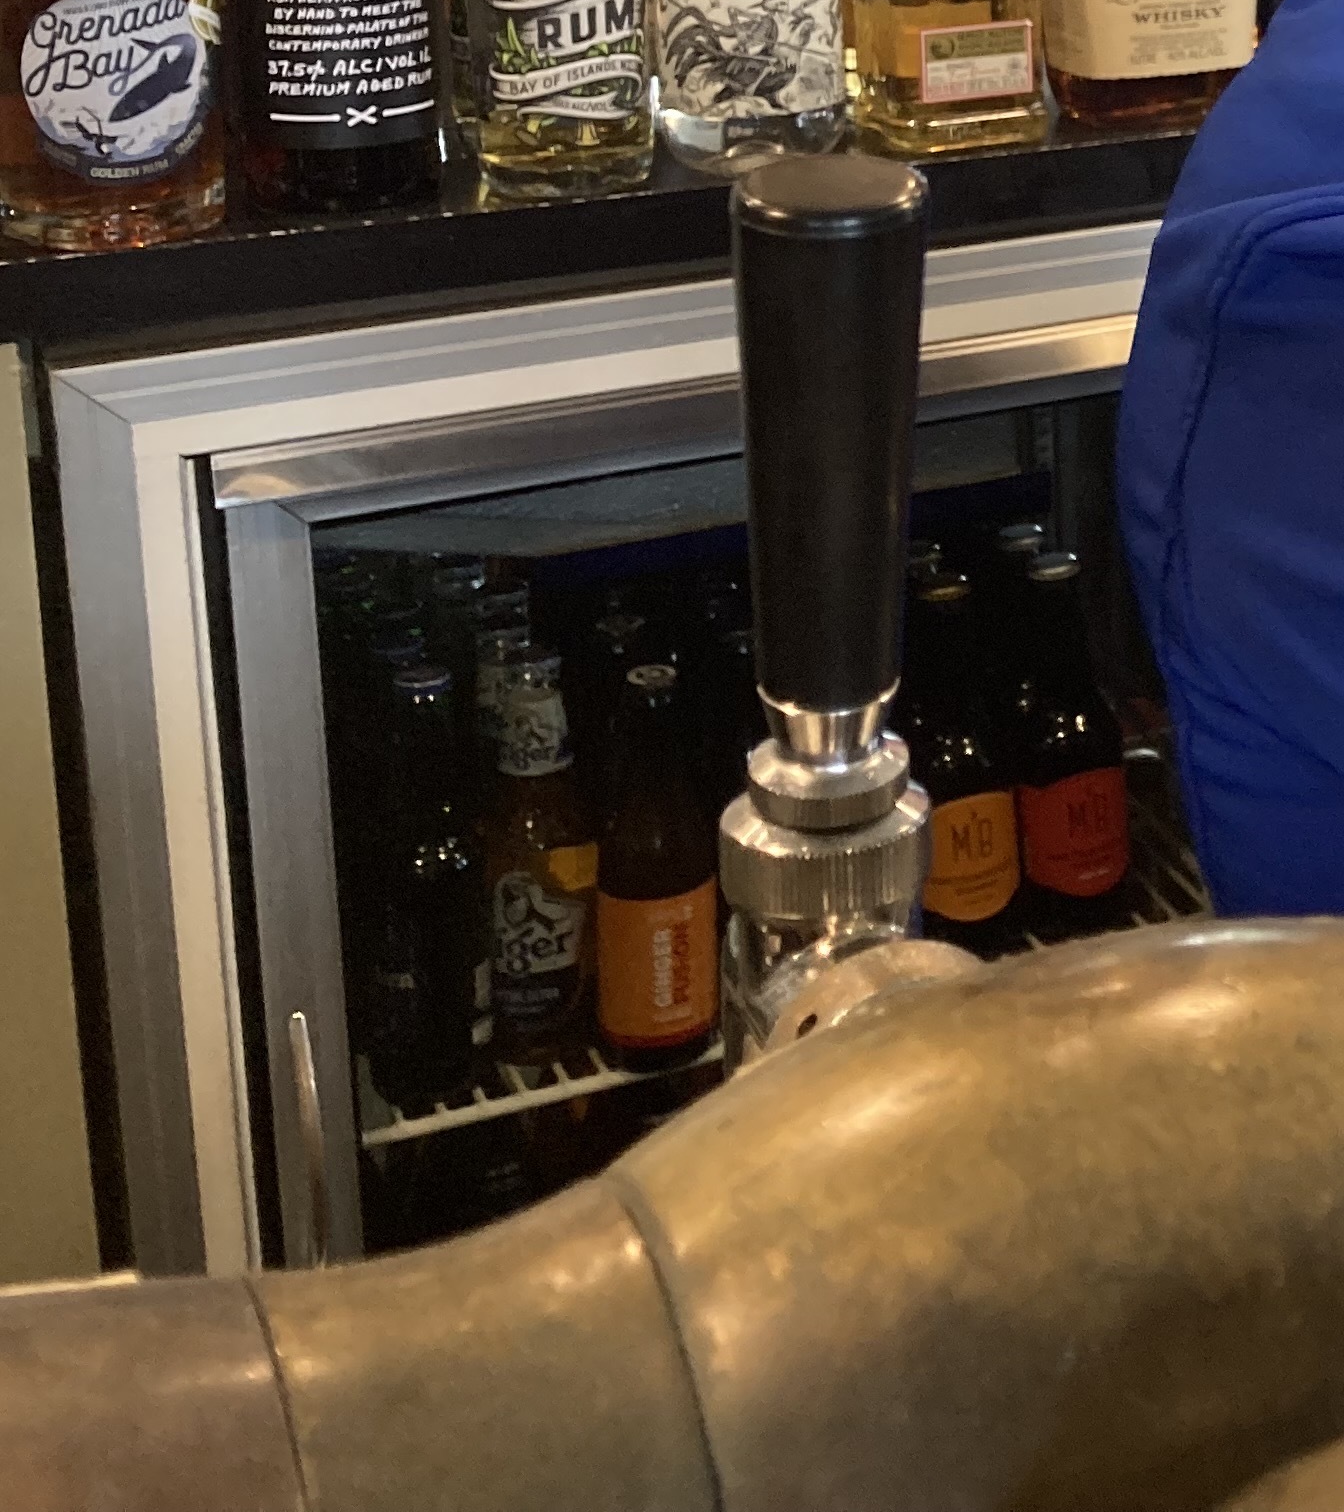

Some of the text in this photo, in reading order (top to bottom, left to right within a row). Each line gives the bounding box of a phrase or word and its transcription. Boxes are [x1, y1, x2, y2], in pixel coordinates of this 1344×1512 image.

[273, 6, 295, 21] BY
[297, 7, 336, 21] HAND
[338, 6, 359, 19] TO
[361, 0, 401, 17] MEET
[1132, 4, 1227, 24] WHISKY
[346, 18, 397, 35] PALATE
[268, 35, 383, 53] CONTEMPORARY
[52, 45, 152, 97] Bay
[509, 78, 538, 96] BAY
[543, 74, 561, 89] OF
[567, 60, 617, 83] ISLANDS
[268, 67, 432, 97] PREMIUM AGED RUM
